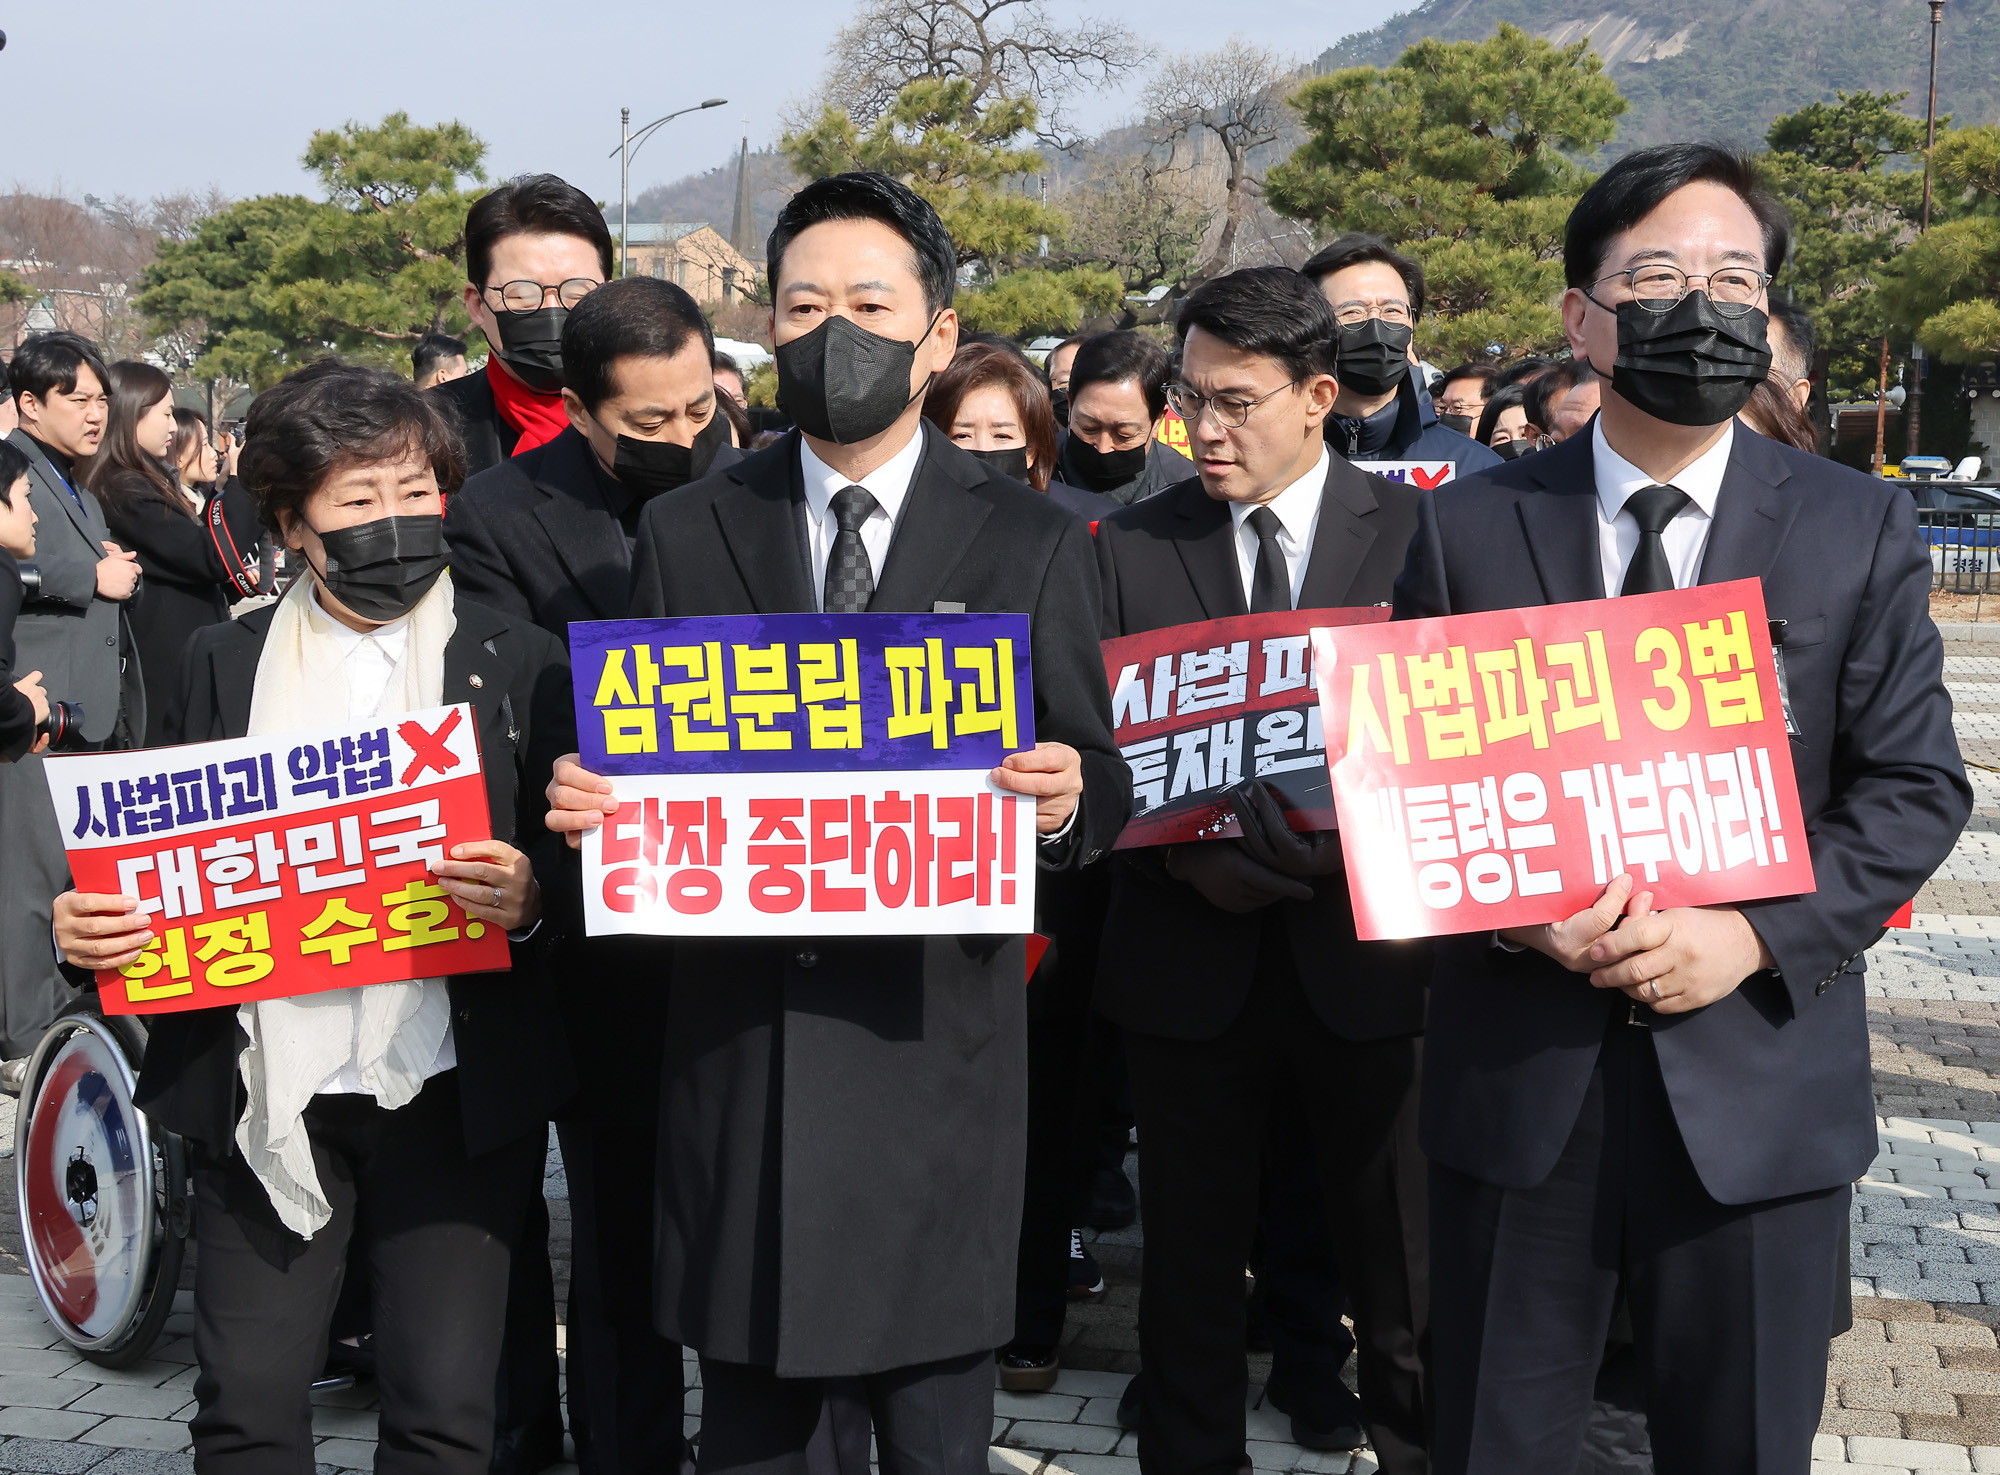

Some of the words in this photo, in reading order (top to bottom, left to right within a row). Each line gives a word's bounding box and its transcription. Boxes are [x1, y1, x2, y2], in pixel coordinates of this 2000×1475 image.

[1953, 558, 1983, 573] 경찰
[593, 638, 863, 755] 삼권분립
[884, 637, 1019, 750] 파괴
[1112, 640, 1250, 729] 사법
[1346, 629, 1621, 766] 사법파괴
[1634, 610, 1765, 731] 3법
[72, 752, 278, 840] 사법파괴
[287, 728, 393, 799] 악법
[1561, 746, 1789, 885] 거부하라!
[116, 799, 447, 919] 대한민국
[601, 797, 728, 914] 당장
[747, 791, 1017, 912] 중단하라!
[118, 911, 275, 1002] 헌정
